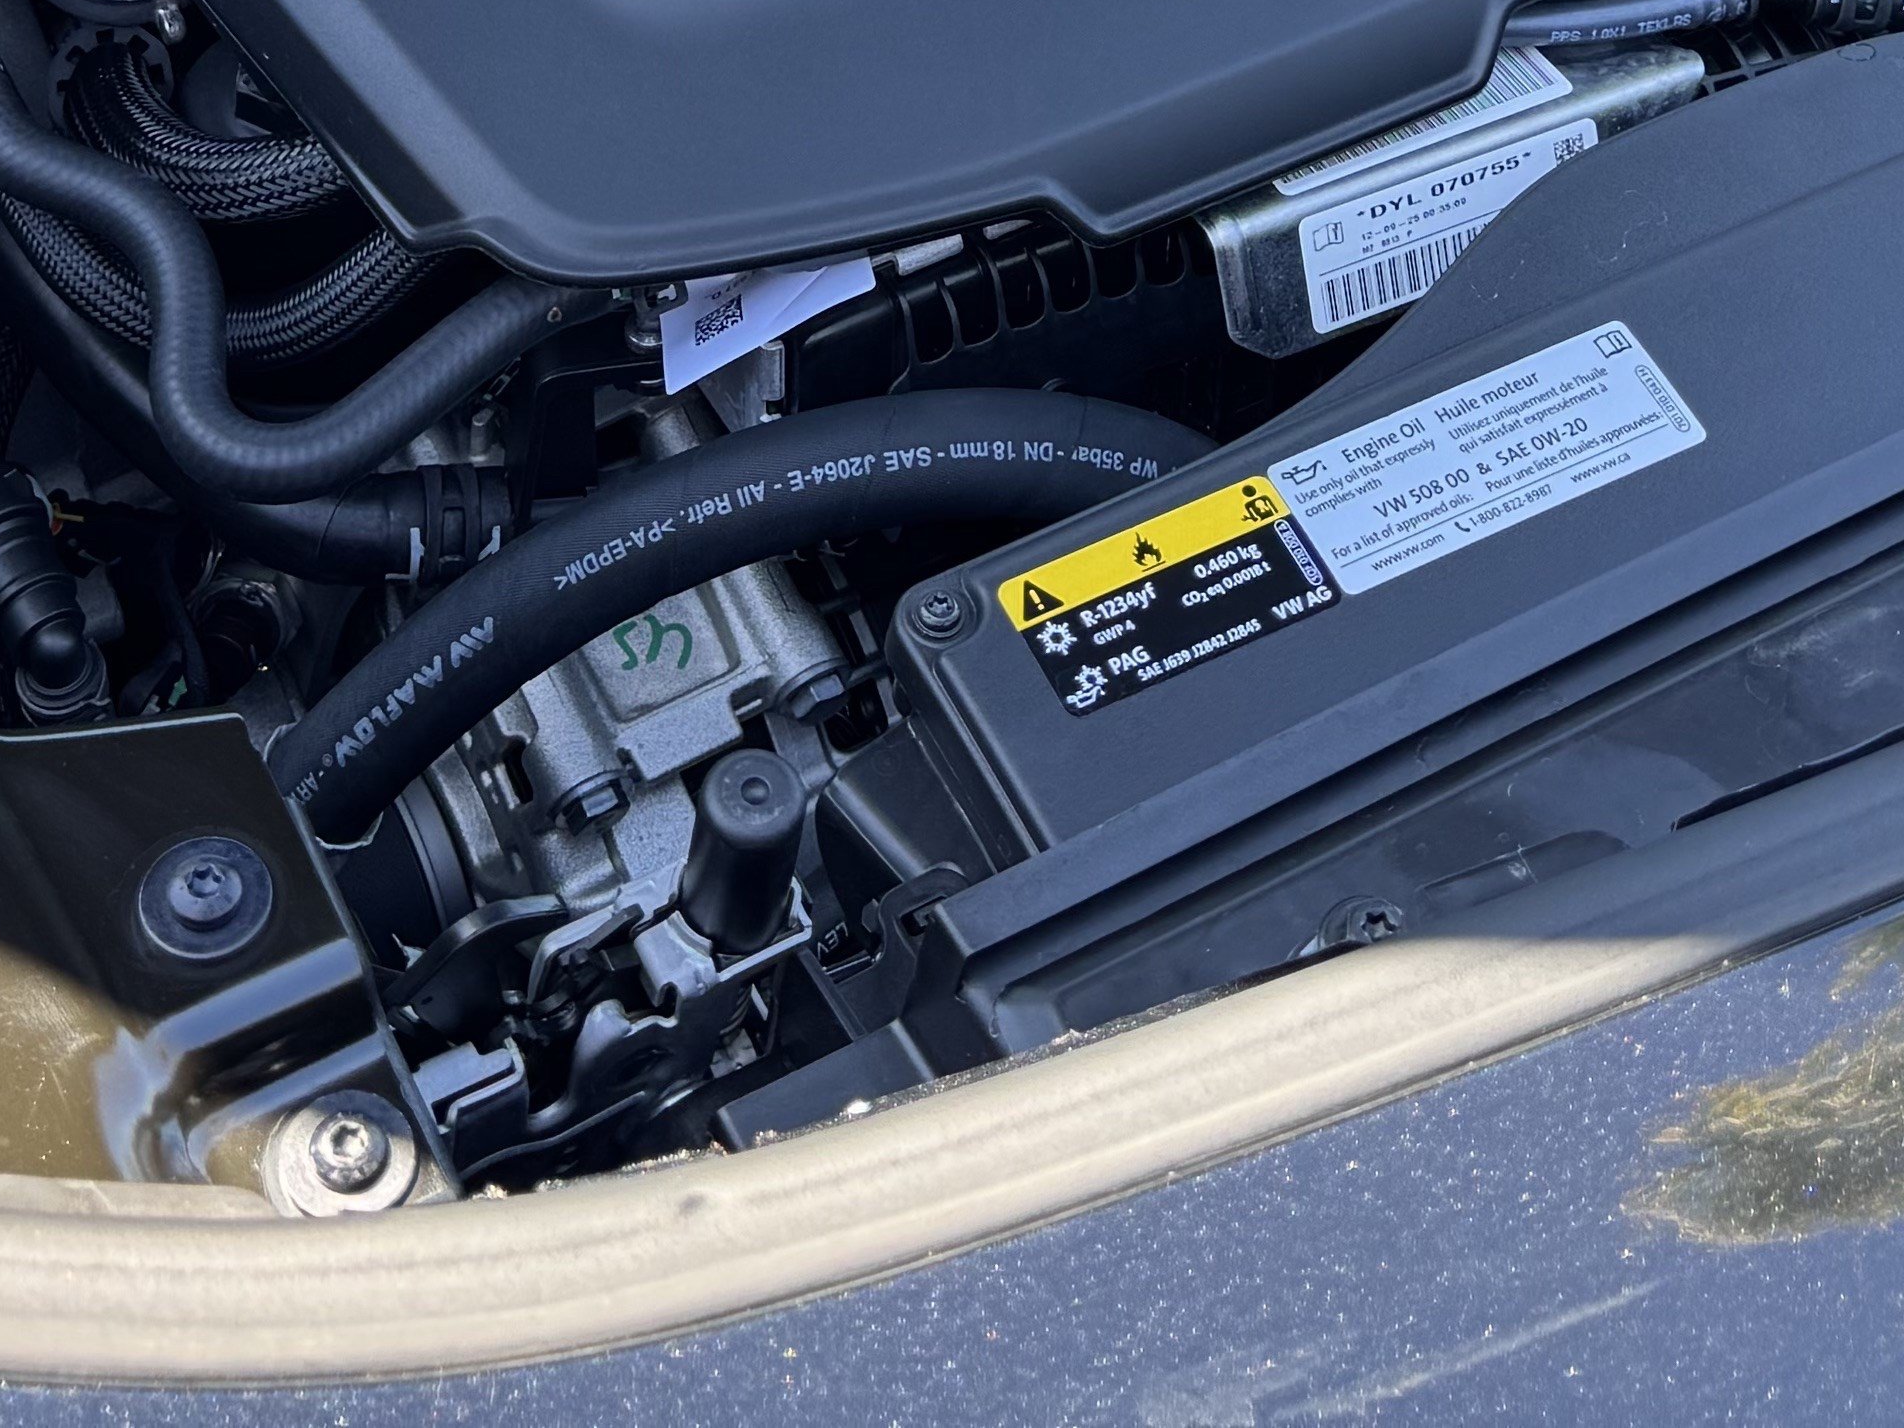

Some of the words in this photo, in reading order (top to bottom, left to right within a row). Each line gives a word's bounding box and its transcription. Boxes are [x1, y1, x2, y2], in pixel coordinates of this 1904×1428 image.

[1433, 395, 1479, 423] Huile
[1477, 369, 1542, 404] moteur
[1447, 414, 1492, 440] Utilisez
[1489, 386, 1561, 424] uniquement
[1555, 379, 1576, 393] de
[1456, 436, 1481, 454] qui
[1475, 417, 1523, 444] satisfait
[1519, 384, 1601, 427] expressément
[1596, 381, 1608, 392] à
[882, 445, 931, 472] SAE
[1023, 441, 1053, 461] DN
[1070, 445, 1124, 470] 35bar
[1340, 429, 1402, 466] Engine
[1396, 417, 1425, 438] Oil
[1484, 473, 1513, 492] Pour
[1510, 464, 1537, 482] une
[1532, 452, 1560, 471] liste
[1596, 408, 1665, 445] approuvées:
[785, 449, 878, 494] J2064-E
[1129, 456, 1158, 477] WP
[1293, 486, 1321, 505] Use
[1316, 475, 1347, 496] only
[1342, 469, 1361, 483] oil
[1357, 458, 1386, 477] that
[1382, 437, 1438, 469] expressly
[1372, 493, 1410, 519] VW
[1407, 478, 1445, 504] 508
[1441, 467, 1472, 489] 00
[1473, 459, 1493, 476] &
[1493, 441, 1531, 466] SAE
[1568, 450, 1632, 484] www.vw.ca
[677, 492, 733, 527] Refr.
[735, 479, 768, 508] All
[1302, 488, 1358, 520] complies
[1353, 476, 1383, 495] with
[1467, 483, 1555, 527] 1-800-822-8987
[1330, 542, 1354, 559] For
[1352, 540, 1363, 550] a
[1359, 530, 1382, 547] list
[1378, 524, 1397, 539] of
[1392, 501, 1451, 534] approved
[1446, 490, 1474, 508] oils:
[1191, 548, 1240, 579] 0.460
[1236, 539, 1263, 564] kg
[1369, 531, 1446, 572] www.vw.com
[1206, 583, 1226, 599] eq
[1221, 562, 1264, 590] 0.0018
[1260, 559, 1272, 572] t
[1077, 580, 1162, 633] R-1234yf
[1270, 595, 1306, 621] VW
[1301, 583, 1334, 608] AG
[1091, 623, 1126, 646] GWP
[1122, 619, 1136, 632] 4
[1136, 661, 1163, 682] SAE
[1160, 648, 1192, 671] J639
[1188, 632, 1228, 658] J2842
[1224, 616, 1262, 642] J2845
[1105, 644, 1152, 676] PAG
